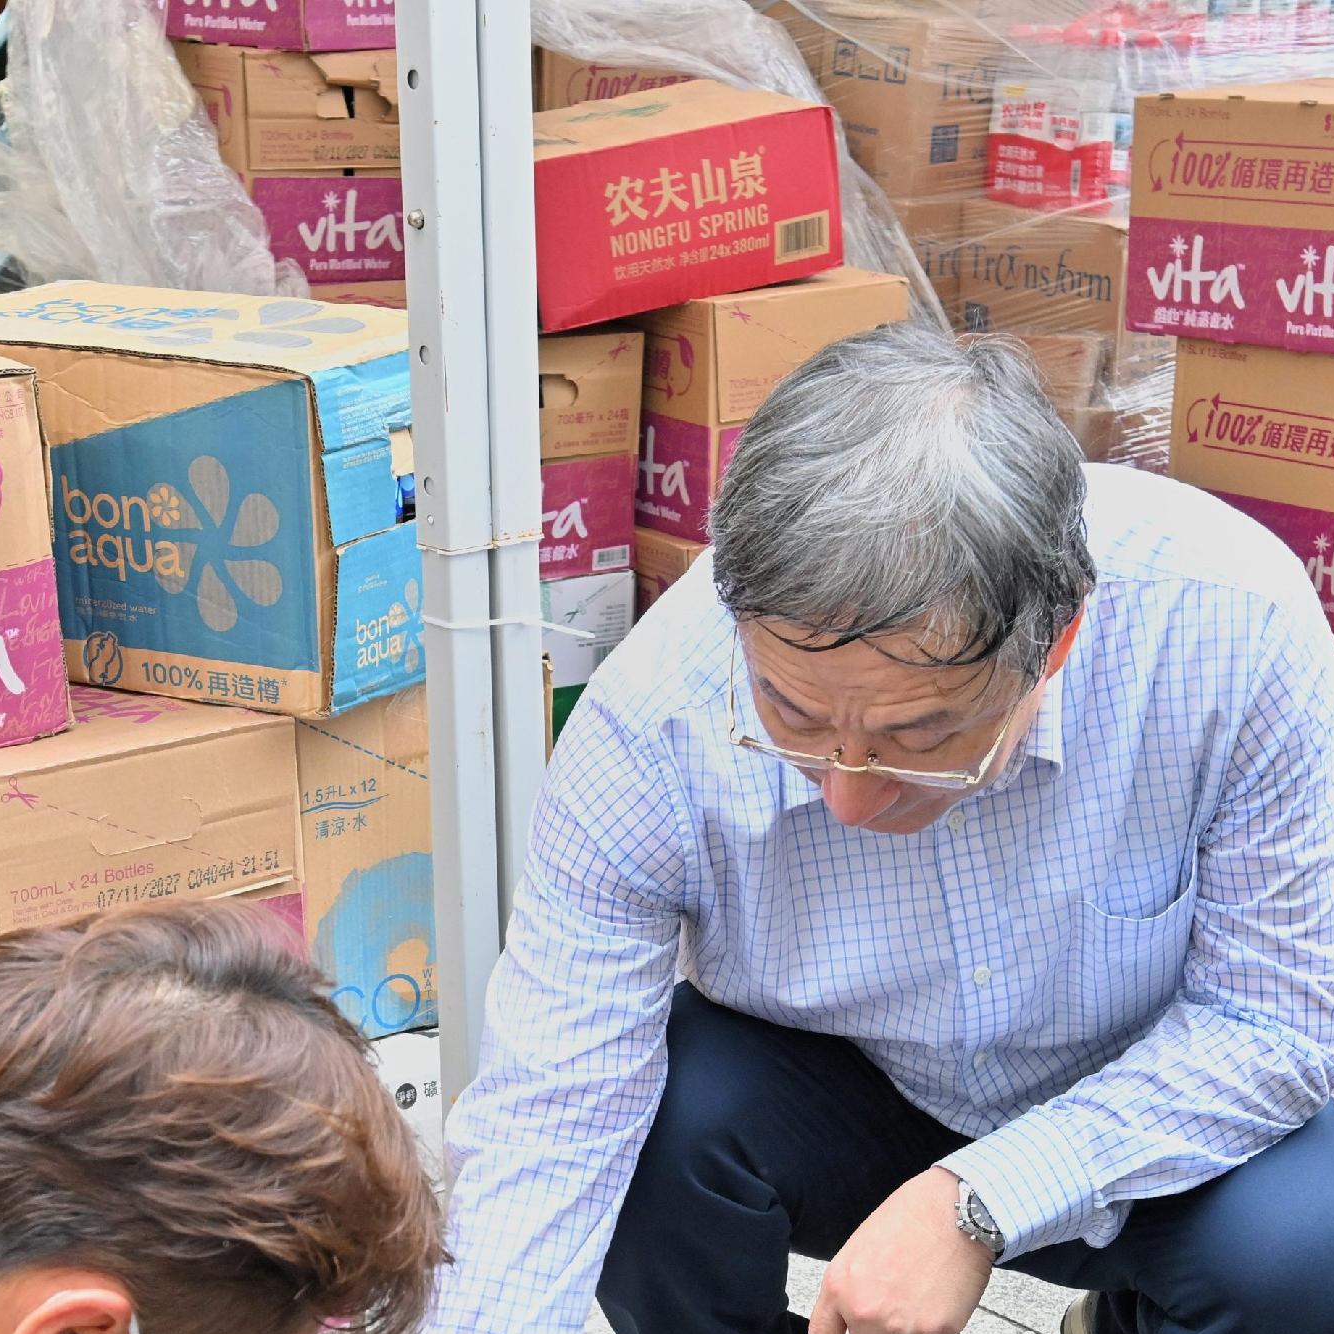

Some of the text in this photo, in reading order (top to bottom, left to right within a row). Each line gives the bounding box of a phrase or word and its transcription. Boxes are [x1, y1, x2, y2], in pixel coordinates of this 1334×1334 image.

[184, 14, 203, 27] Pure
[240, 17, 267, 31] Water
[604, 150, 768, 227] 农夫山泉
[298, 188, 404, 252] vita
[610, 203, 769, 258] NONGFU SPRING
[613, 255, 676, 281] 饮用天然水
[1146, 234, 1246, 310] vita
[1286, 321, 1305, 338] Pure
[639, 425, 692, 506] ta
[61, 474, 151, 532] bon
[68, 528, 185, 582] aqua
[355, 615, 390, 645] bon
[356, 635, 403, 669] aqua
[359, 777, 378, 793] 12
[10, 884, 64, 905] 700mL
[80, 874, 99, 890] 24
[104, 860, 155, 884] Bottles
